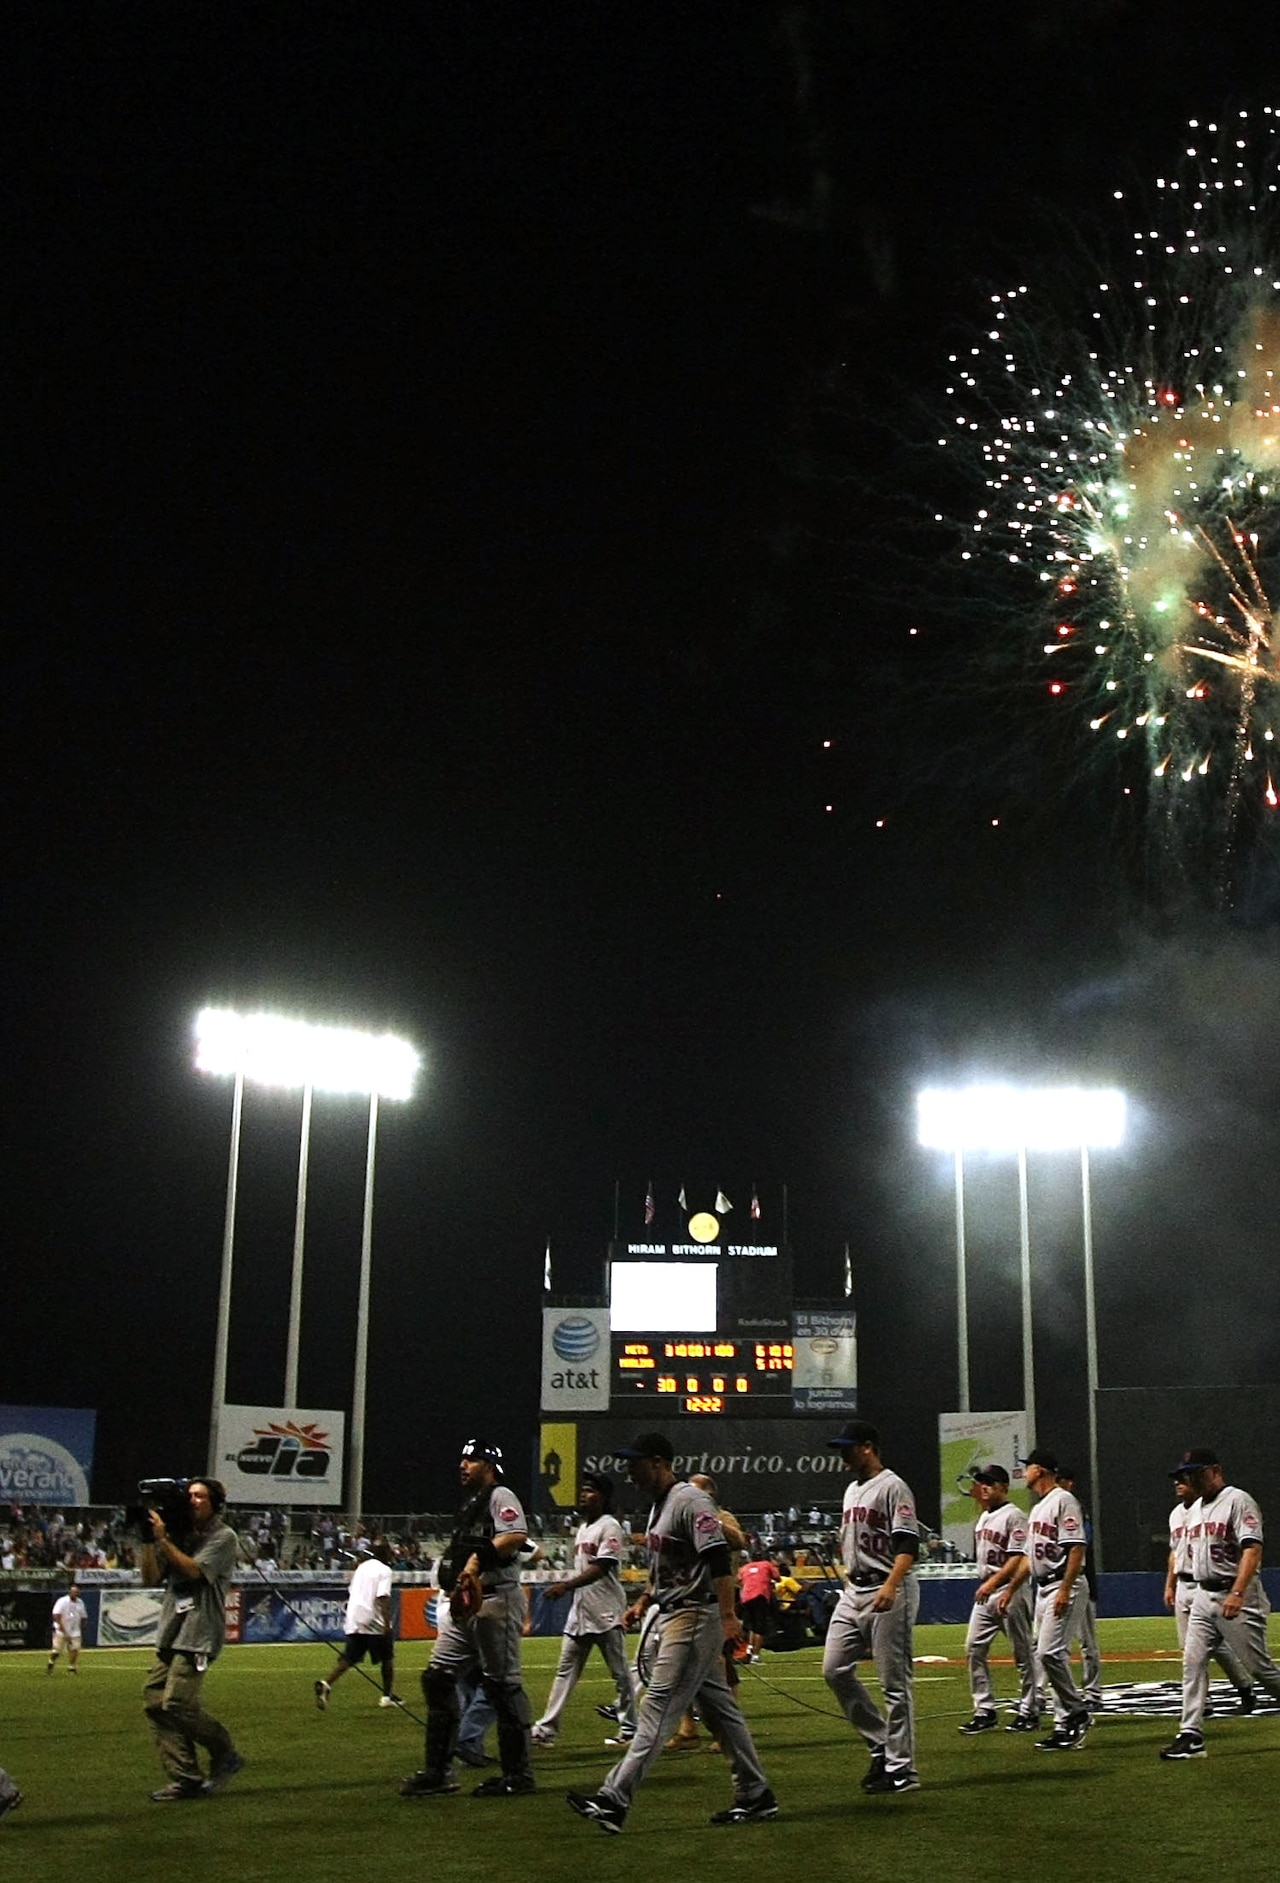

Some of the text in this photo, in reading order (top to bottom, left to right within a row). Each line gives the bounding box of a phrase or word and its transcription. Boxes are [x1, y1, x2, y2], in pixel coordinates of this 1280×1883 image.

[628, 1244, 778, 1257] HIRAM BITHORN STADIUM
[550, 1370, 600, 1389] at&t
[584, 1446, 850, 1484] seeertorico.com
[859, 1532, 888, 1555] 30
[1035, 1543, 1057, 1561] 56
